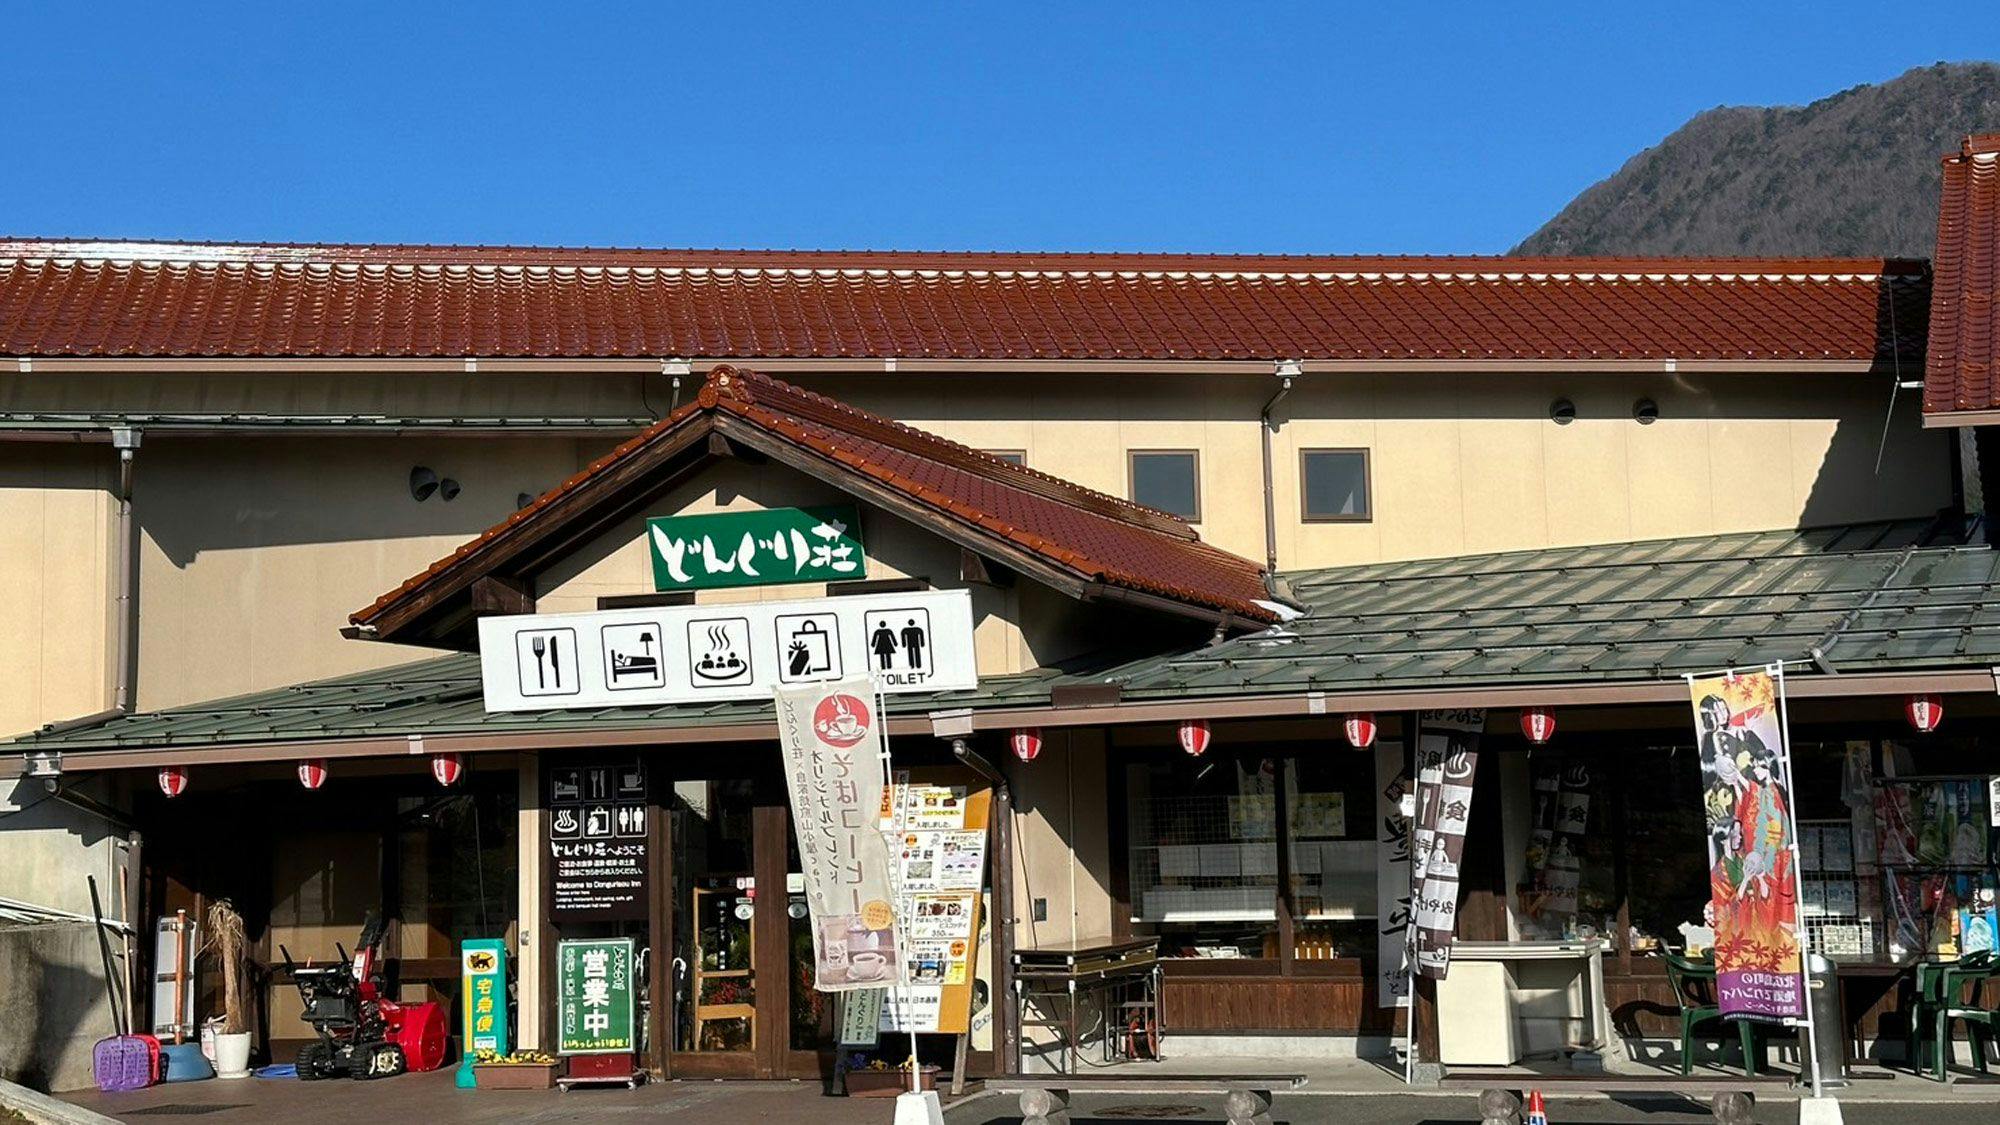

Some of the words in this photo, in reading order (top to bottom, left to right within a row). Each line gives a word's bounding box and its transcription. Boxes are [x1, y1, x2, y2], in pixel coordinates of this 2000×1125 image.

[652, 519, 858, 584] どんぐり荘
[556, 882, 585, 890] Welcome
[586, 881, 593, 889] to
[631, 880, 642, 888] Inn
[476, 977, 493, 1033] 宅急便
[582, 949, 610, 1038] 営業中
